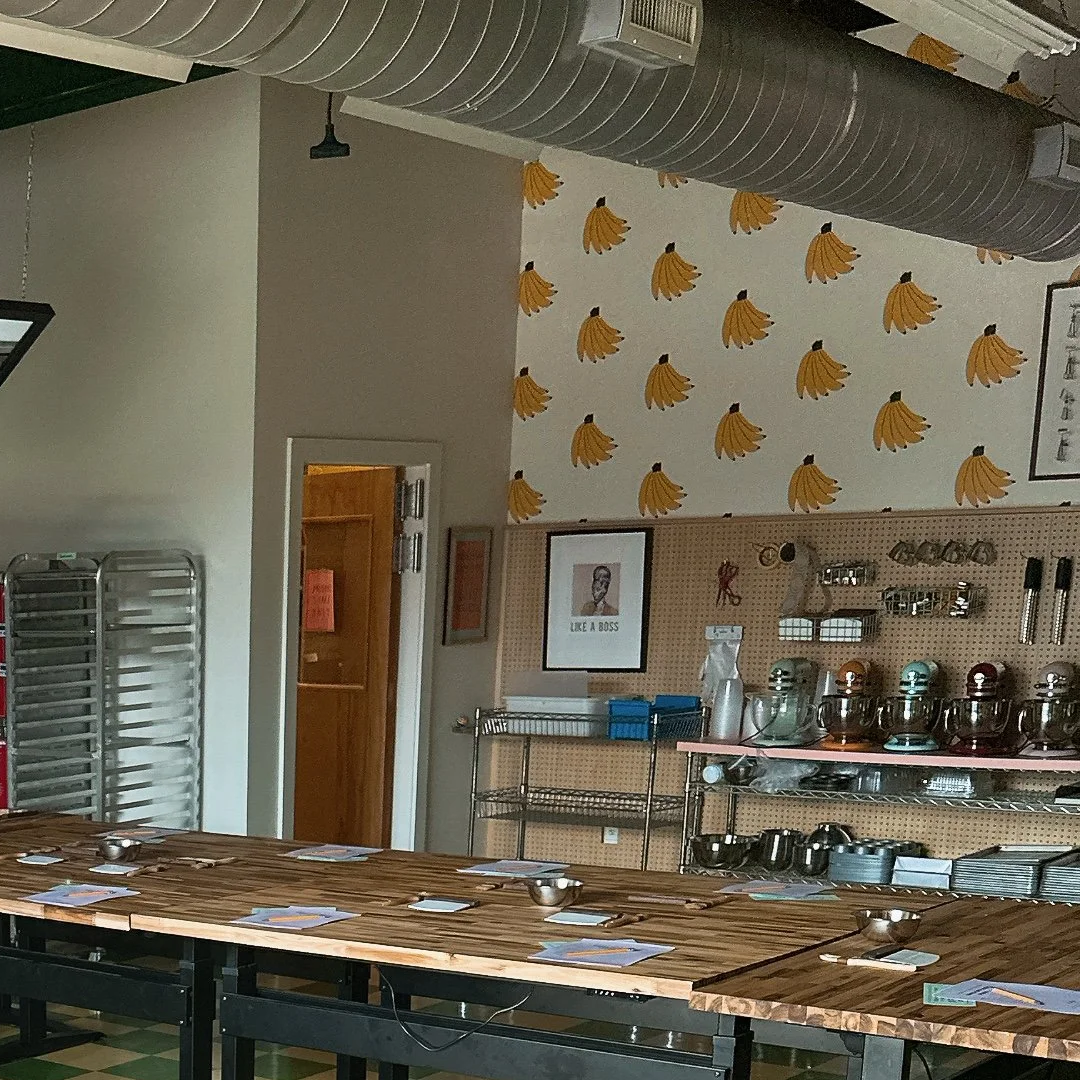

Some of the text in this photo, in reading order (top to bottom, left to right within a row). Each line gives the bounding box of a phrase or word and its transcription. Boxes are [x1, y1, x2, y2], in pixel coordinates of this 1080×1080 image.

[570, 621, 619, 632] LIKE A BOSS
